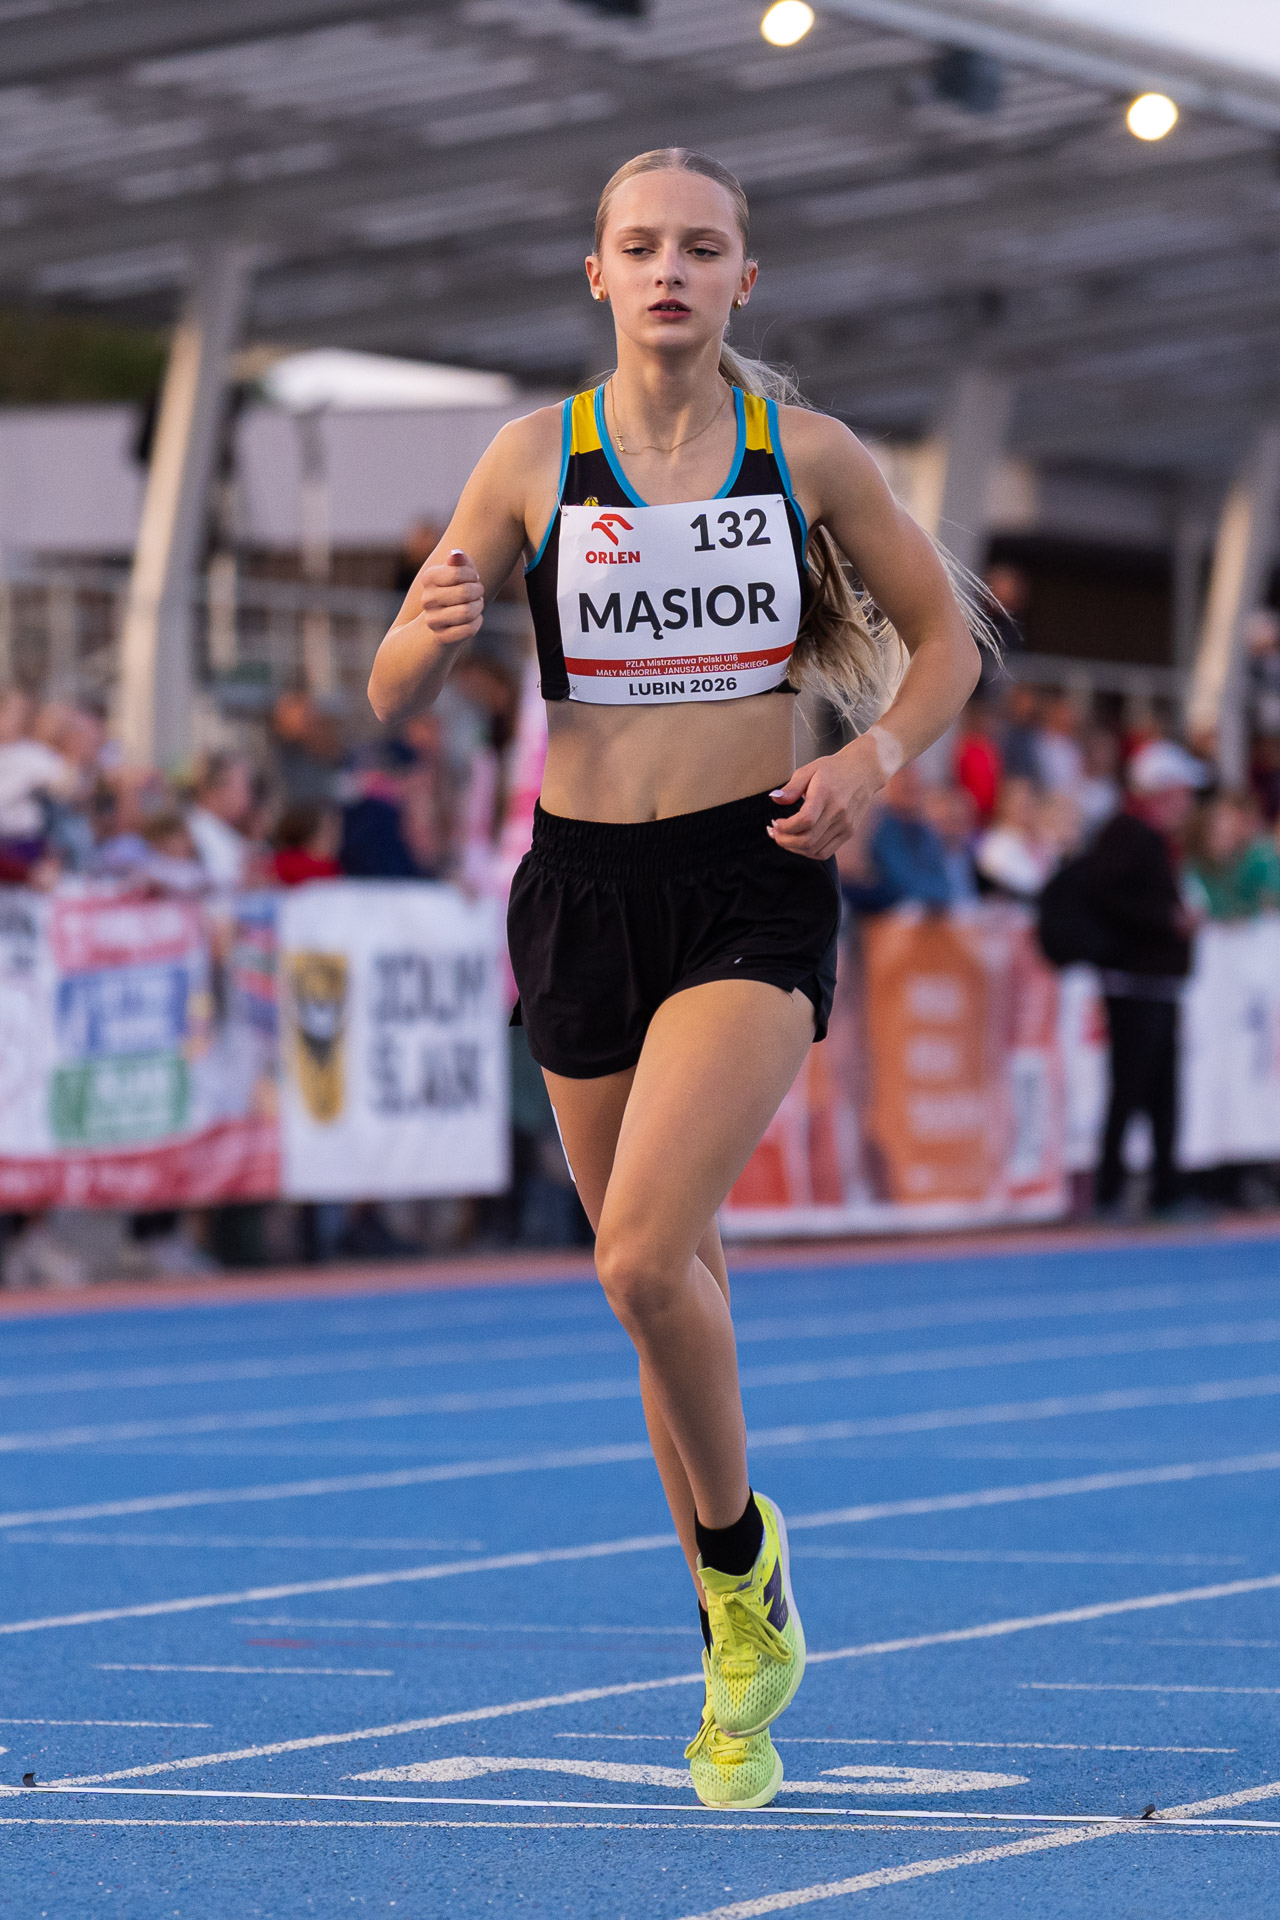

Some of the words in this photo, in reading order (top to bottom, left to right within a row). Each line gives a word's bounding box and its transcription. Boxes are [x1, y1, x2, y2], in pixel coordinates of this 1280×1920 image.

[690, 508, 771, 552] 132
[585, 550, 641, 565] ORLEN
[578, 581, 780, 640] MĄSIOR
[596, 669, 618, 677] MAŁY
[619, 668, 662, 677] MEMORIAŁ
[663, 666, 702, 675] JANUSZA
[702, 659, 769, 673] KUSOCIŃSKIEGO
[625, 660, 646, 668] PZLA
[647, 657, 697, 667] Mistrzostwa
[698, 654, 723, 664] Polski
[723, 654, 739, 662] U16
[628, 680, 685, 696] LUBIN
[690, 677, 738, 693] 2026
